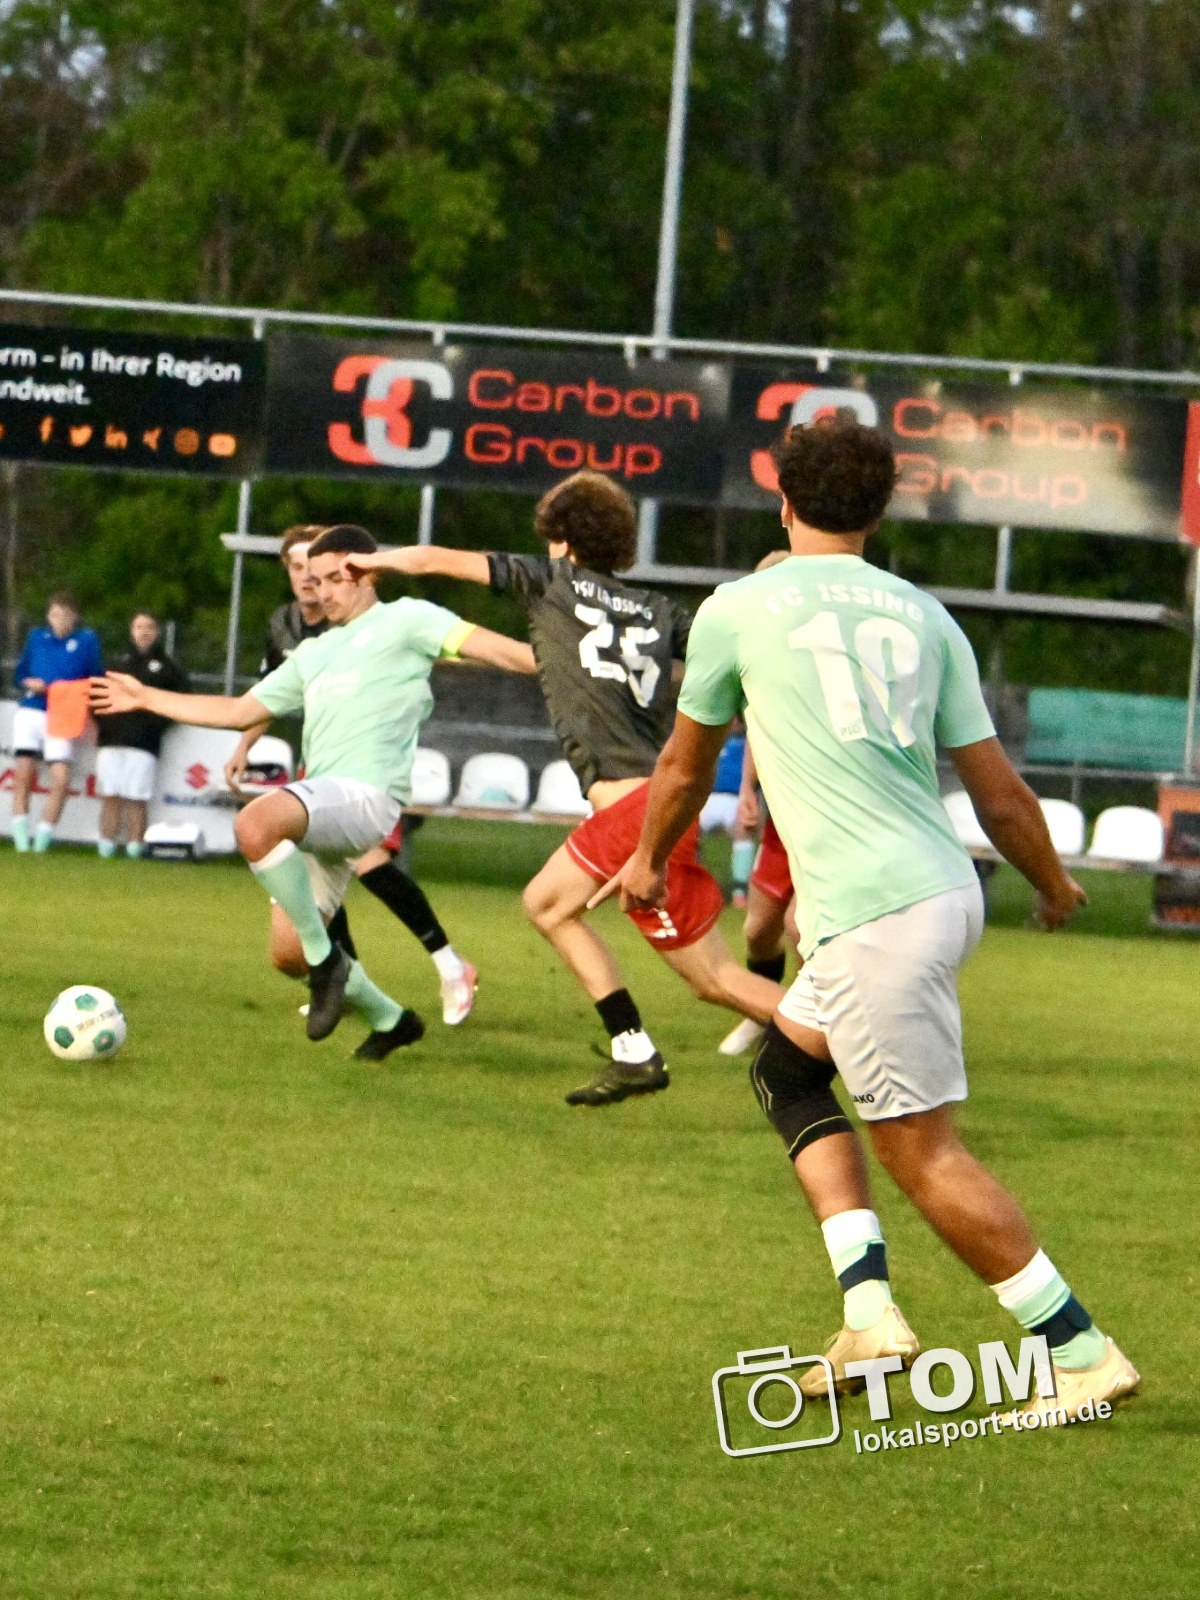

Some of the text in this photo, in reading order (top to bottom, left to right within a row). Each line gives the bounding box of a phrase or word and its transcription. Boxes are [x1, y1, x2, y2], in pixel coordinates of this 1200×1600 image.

[60, 345, 84, 371] in
[92, 349, 151, 376] Ihrer
[156, 352, 242, 387] Region
[467, 368, 699, 423] Carbon
[464, 422, 663, 480] Group
[892, 397, 1128, 456] Carbon
[895, 451, 1088, 508] Group
[816, 583, 924, 623] ISSING
[574, 603, 661, 708] 25
[853, 1093, 875, 1104] AKO
